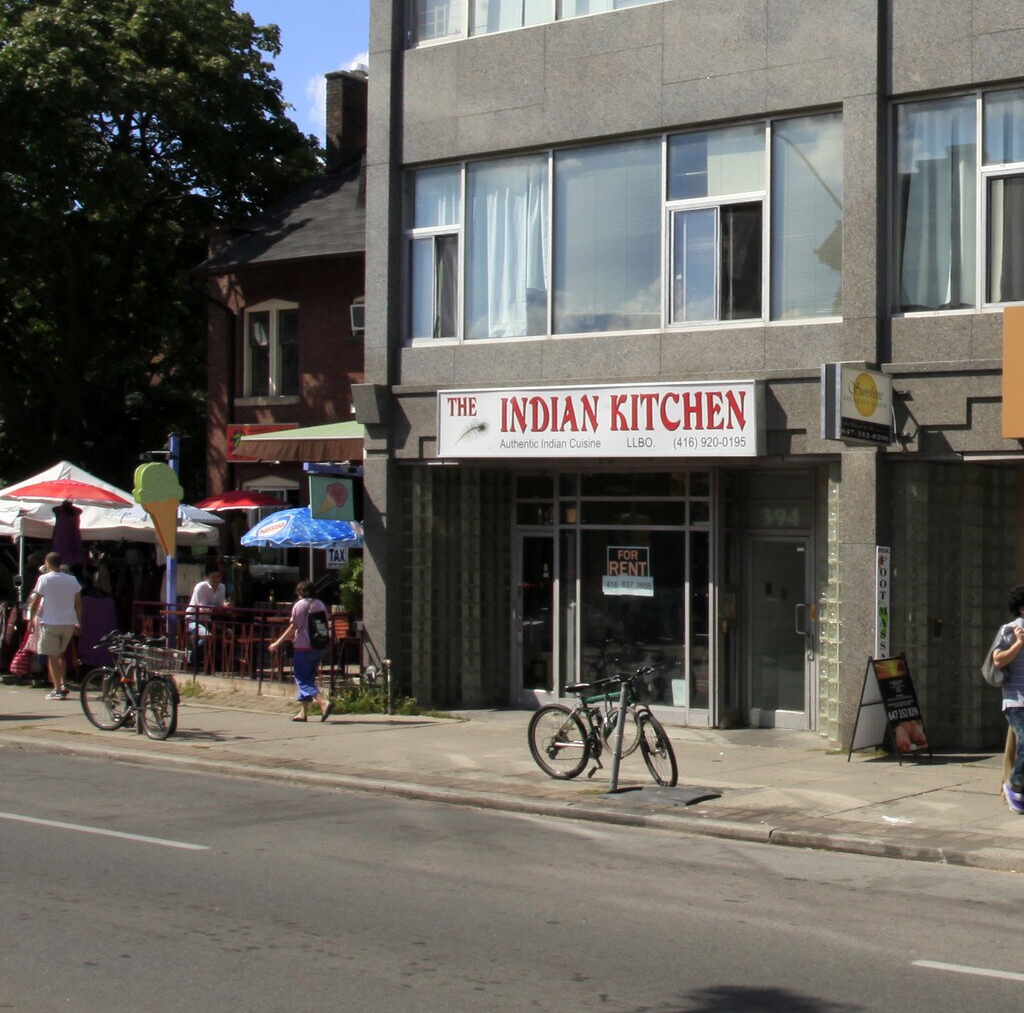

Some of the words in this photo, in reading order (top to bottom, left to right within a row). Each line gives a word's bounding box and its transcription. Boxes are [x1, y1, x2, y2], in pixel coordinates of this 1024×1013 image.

[447, 397, 477, 417] THE
[500, 394, 599, 434] INDIAN
[610, 390, 746, 431] KITCHEN
[499, 439, 539, 449] Authentic
[541, 438, 567, 449] Indian
[569, 438, 601, 449] Cuisine
[673, 436, 698, 450] (416)
[700, 436, 746, 448] 920-0195
[762, 508, 799, 526] 394
[328, 548, 346, 562] TAX
[617, 549, 638, 561] FOR
[608, 560, 647, 576] RENT
[606, 581, 618, 589] 416
[621, 580, 634, 589] 837
